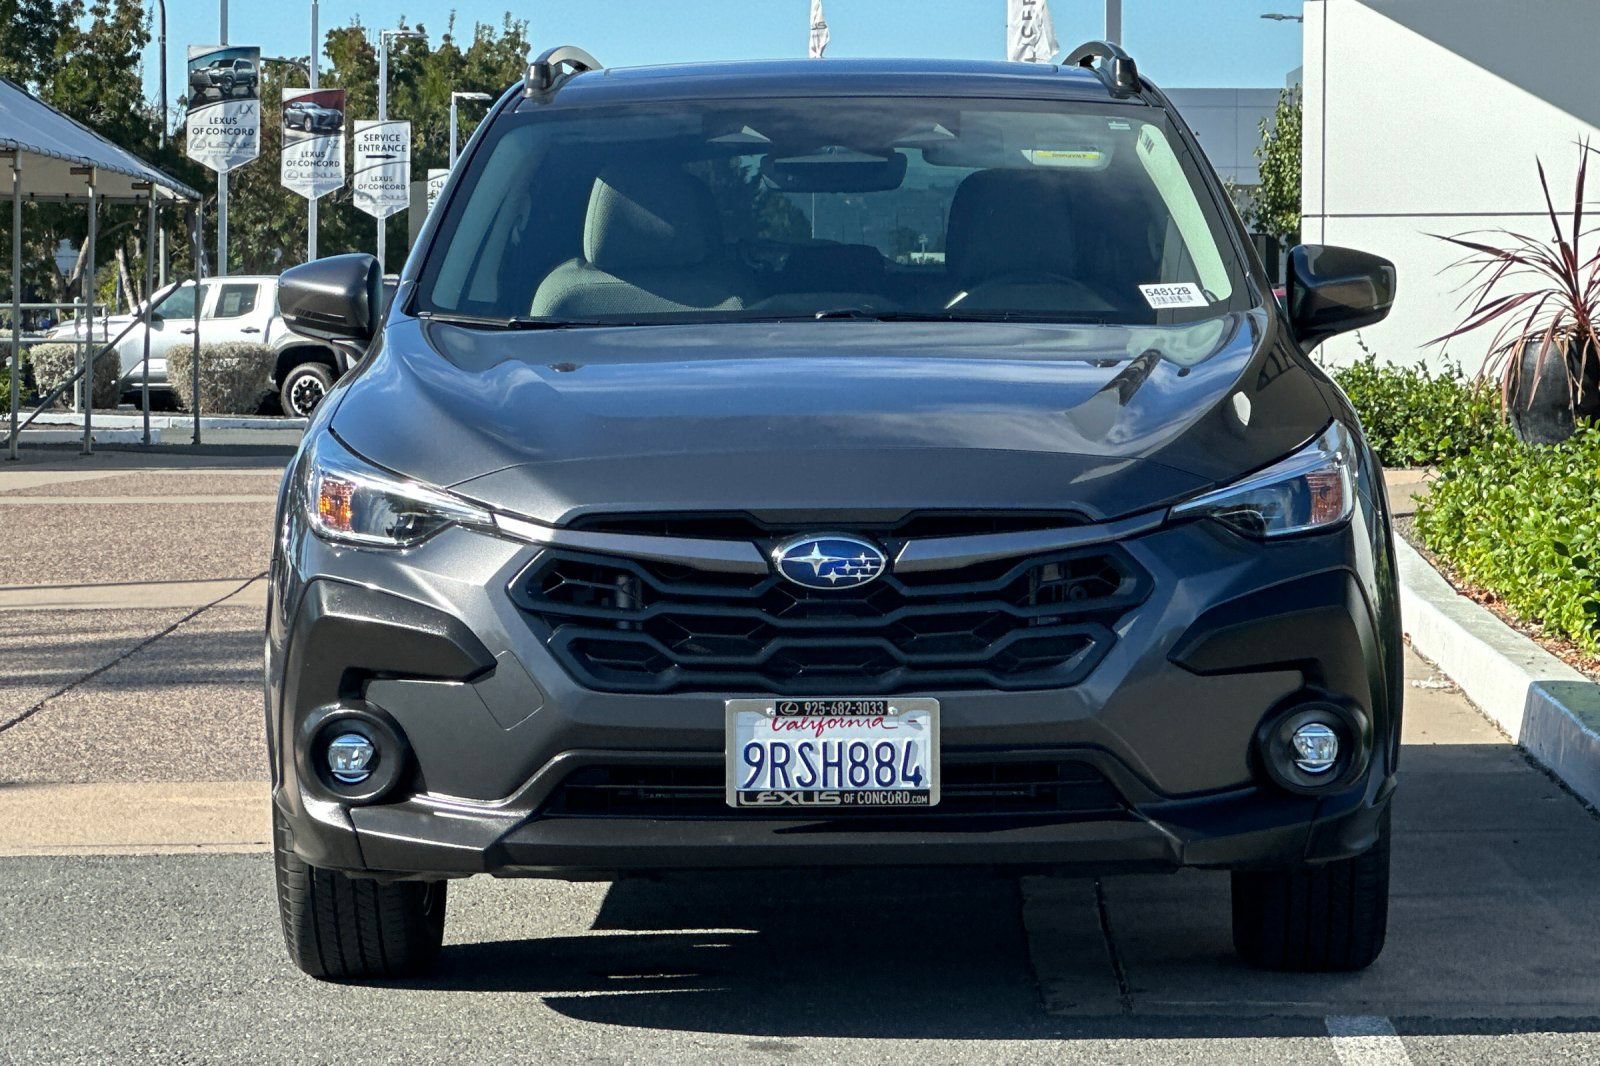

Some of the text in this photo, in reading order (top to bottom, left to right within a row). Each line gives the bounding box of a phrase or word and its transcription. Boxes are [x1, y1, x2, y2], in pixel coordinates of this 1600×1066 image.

[240, 104, 254, 114] LX
[209, 117, 238, 125] LEXUS
[192, 127, 255, 136] OF CONCORD
[363, 133, 401, 142] SERVICE
[358, 144, 407, 152] ENTRANCE
[804, 701, 885, 716] 925-682-3033
[771, 716, 899, 738] California
[742, 740, 923, 788] 9RSH884
[738, 791, 842, 805] LEXUS
[843, 793, 855, 804] OF
